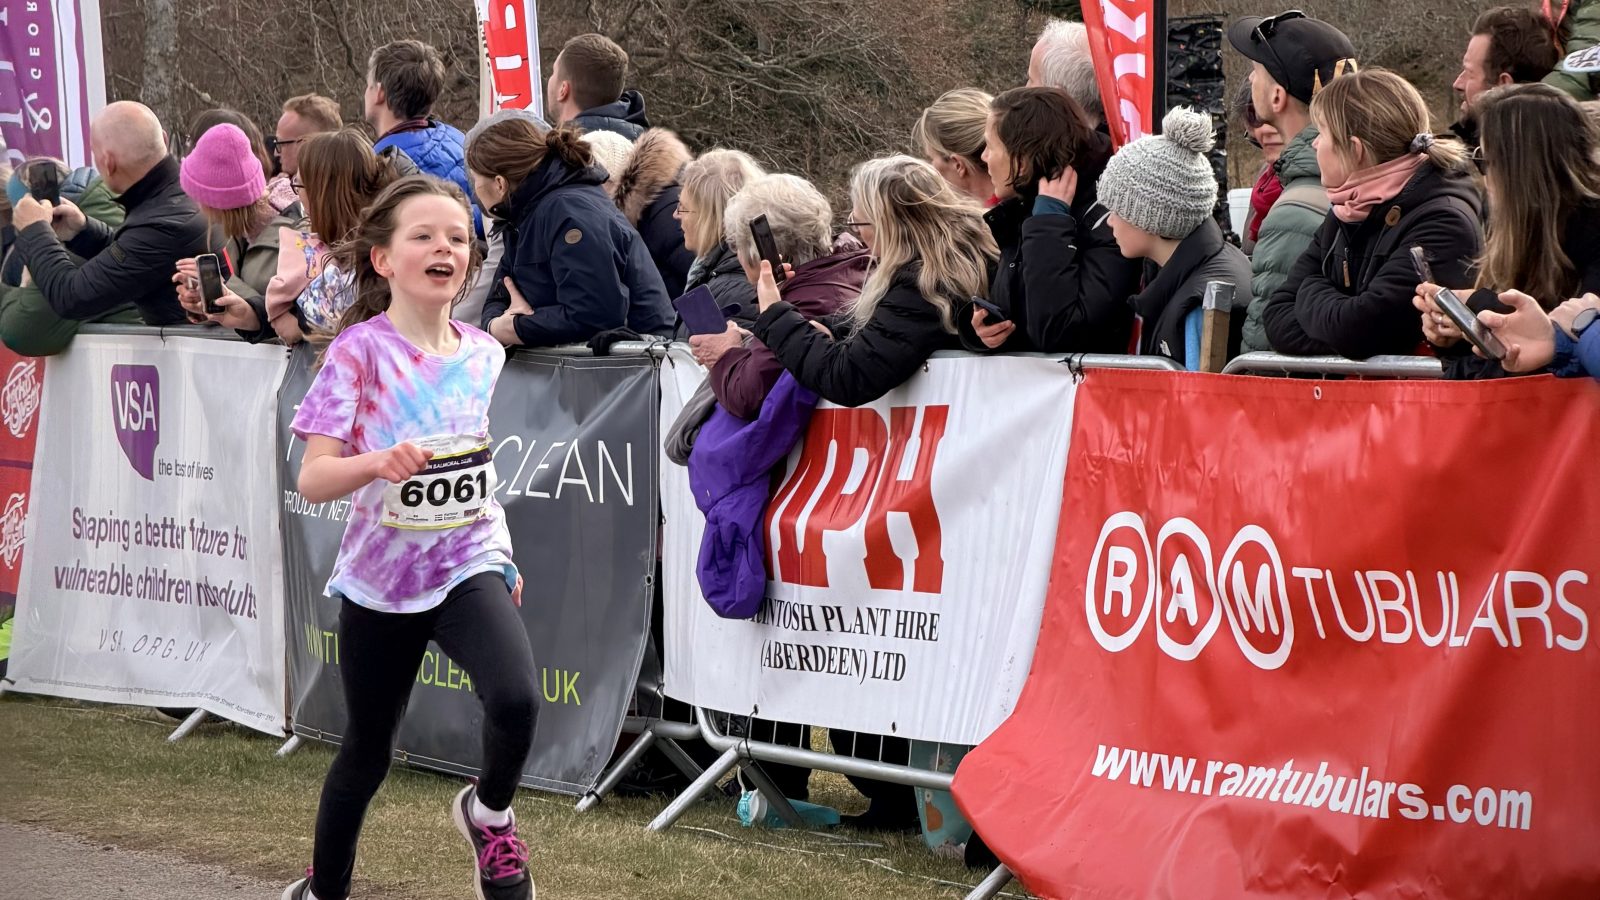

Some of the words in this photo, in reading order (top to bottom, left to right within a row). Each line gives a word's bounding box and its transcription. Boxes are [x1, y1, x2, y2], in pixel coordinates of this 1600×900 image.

[115, 381, 157, 432] VSA
[158, 458, 173, 476] the
[401, 470, 487, 507] 6061
[73, 506, 130, 552] Shaping
[135, 520, 143, 545] a
[145, 513, 187, 550] better
[54, 560, 133, 597] vulnerable
[136, 566, 192, 605] children
[1103, 545, 1281, 637] RAM
[1291, 566, 1589, 652] TUBULARS
[822, 605, 892, 638] PLANT
[895, 609, 941, 643] HIRE
[760, 639, 868, 685] (ABERDEEN)
[871, 650, 907, 683] LTD
[1091, 744, 1533, 831] www.ramtubulars.com
